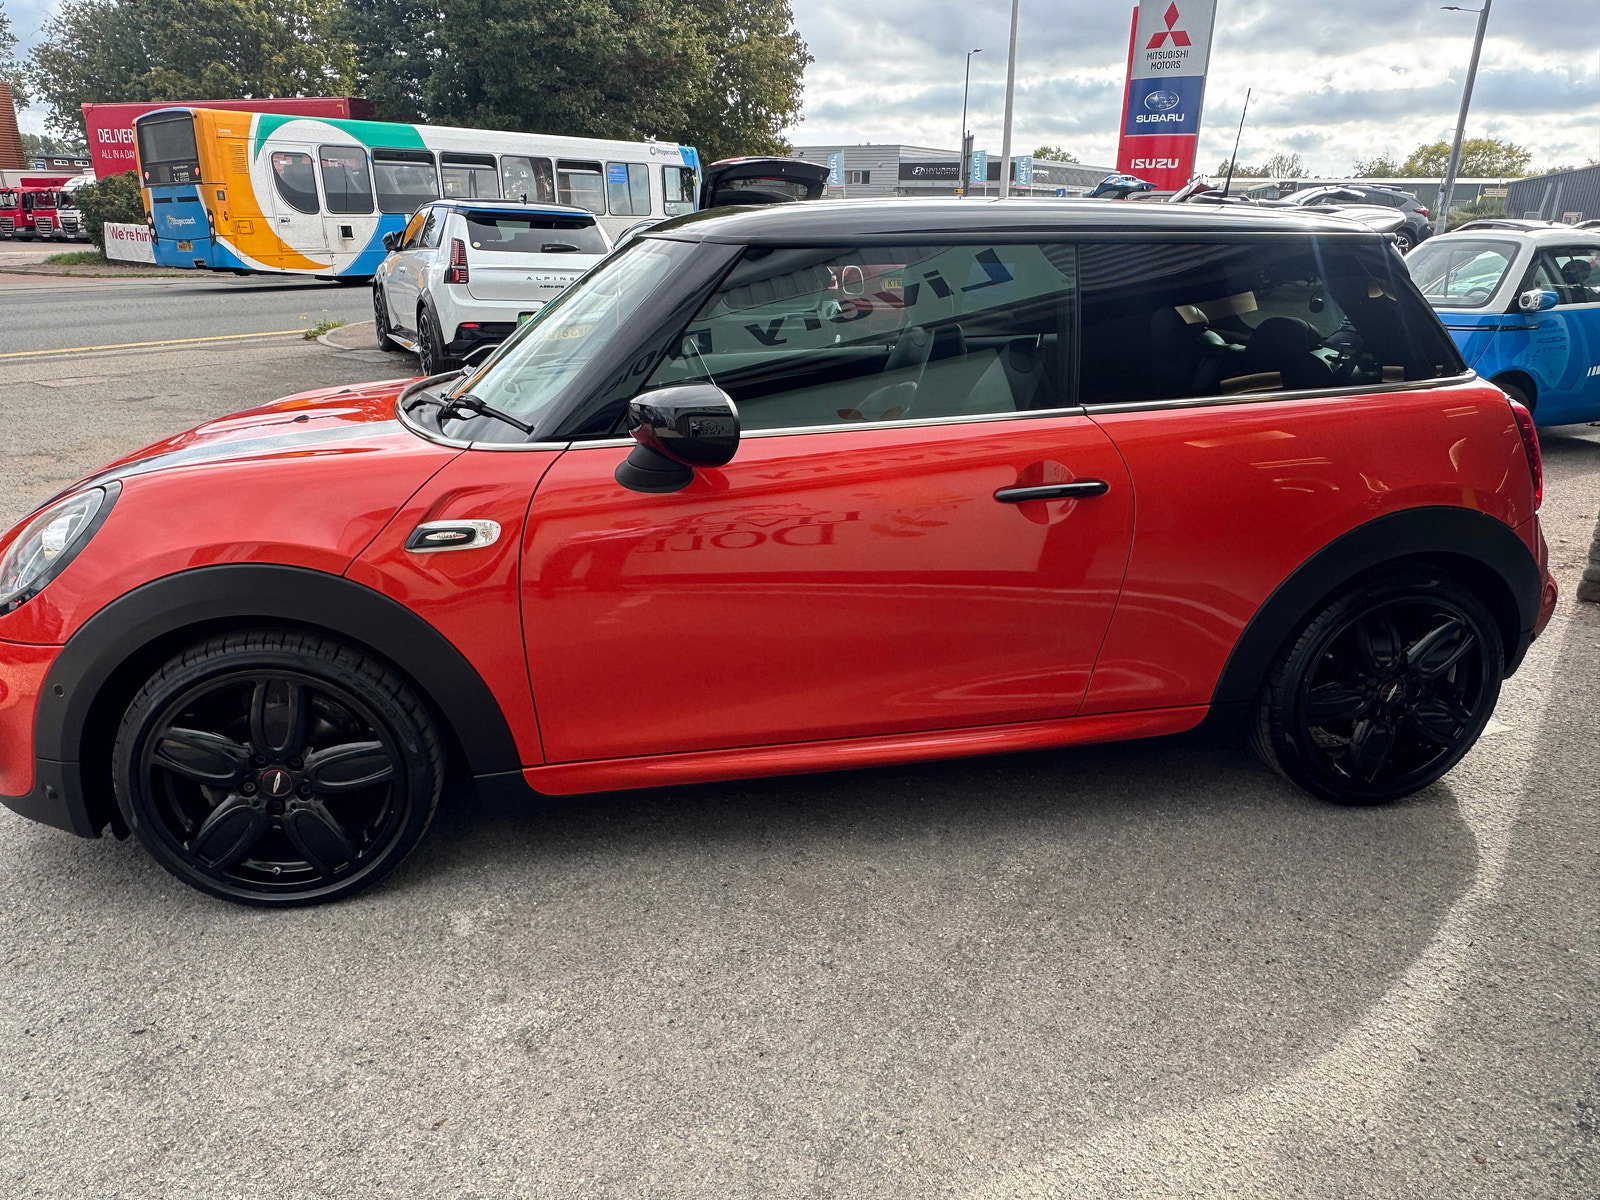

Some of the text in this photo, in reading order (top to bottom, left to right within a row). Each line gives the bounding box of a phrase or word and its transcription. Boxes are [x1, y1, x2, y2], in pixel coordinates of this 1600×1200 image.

[1146, 50, 1189, 60] MITSUBISHI
[1150, 60, 1181, 70] MOTORS
[1135, 113, 1185, 123] SUBARU
[97, 128, 135, 143] DELIVER
[101, 149, 113, 159] ALL
[1130, 158, 1179, 169] ISUZU
[925, 167, 959, 175] HYUNDAI
[110, 226, 135, 241] We're
